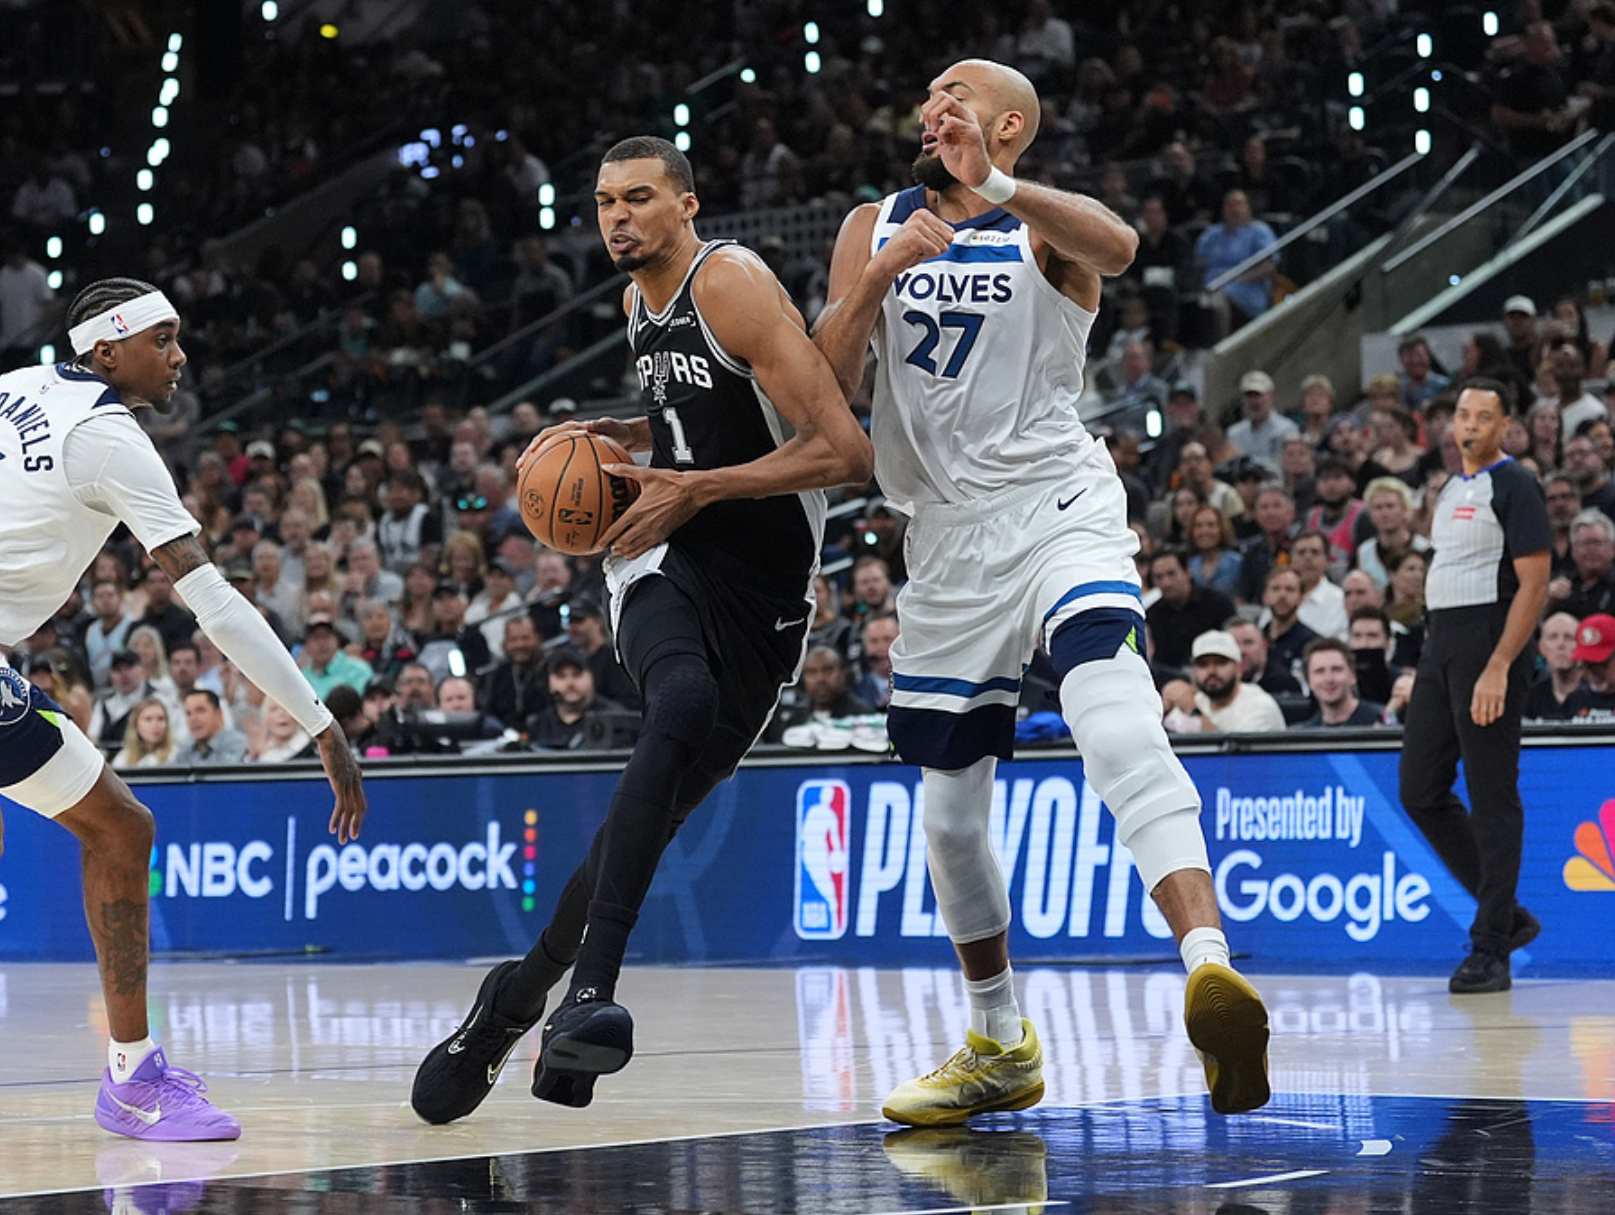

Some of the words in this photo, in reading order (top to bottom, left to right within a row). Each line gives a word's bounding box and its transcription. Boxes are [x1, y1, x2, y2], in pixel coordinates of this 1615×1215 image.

[903, 310, 985, 379] 27
[663, 407, 694, 464] 1
[1215, 785, 1332, 840] Presented
[1335, 785, 1365, 848] by
[165, 840, 273, 898] NBC
[305, 821, 518, 919] peacock
[1214, 849, 1431, 942] Google
